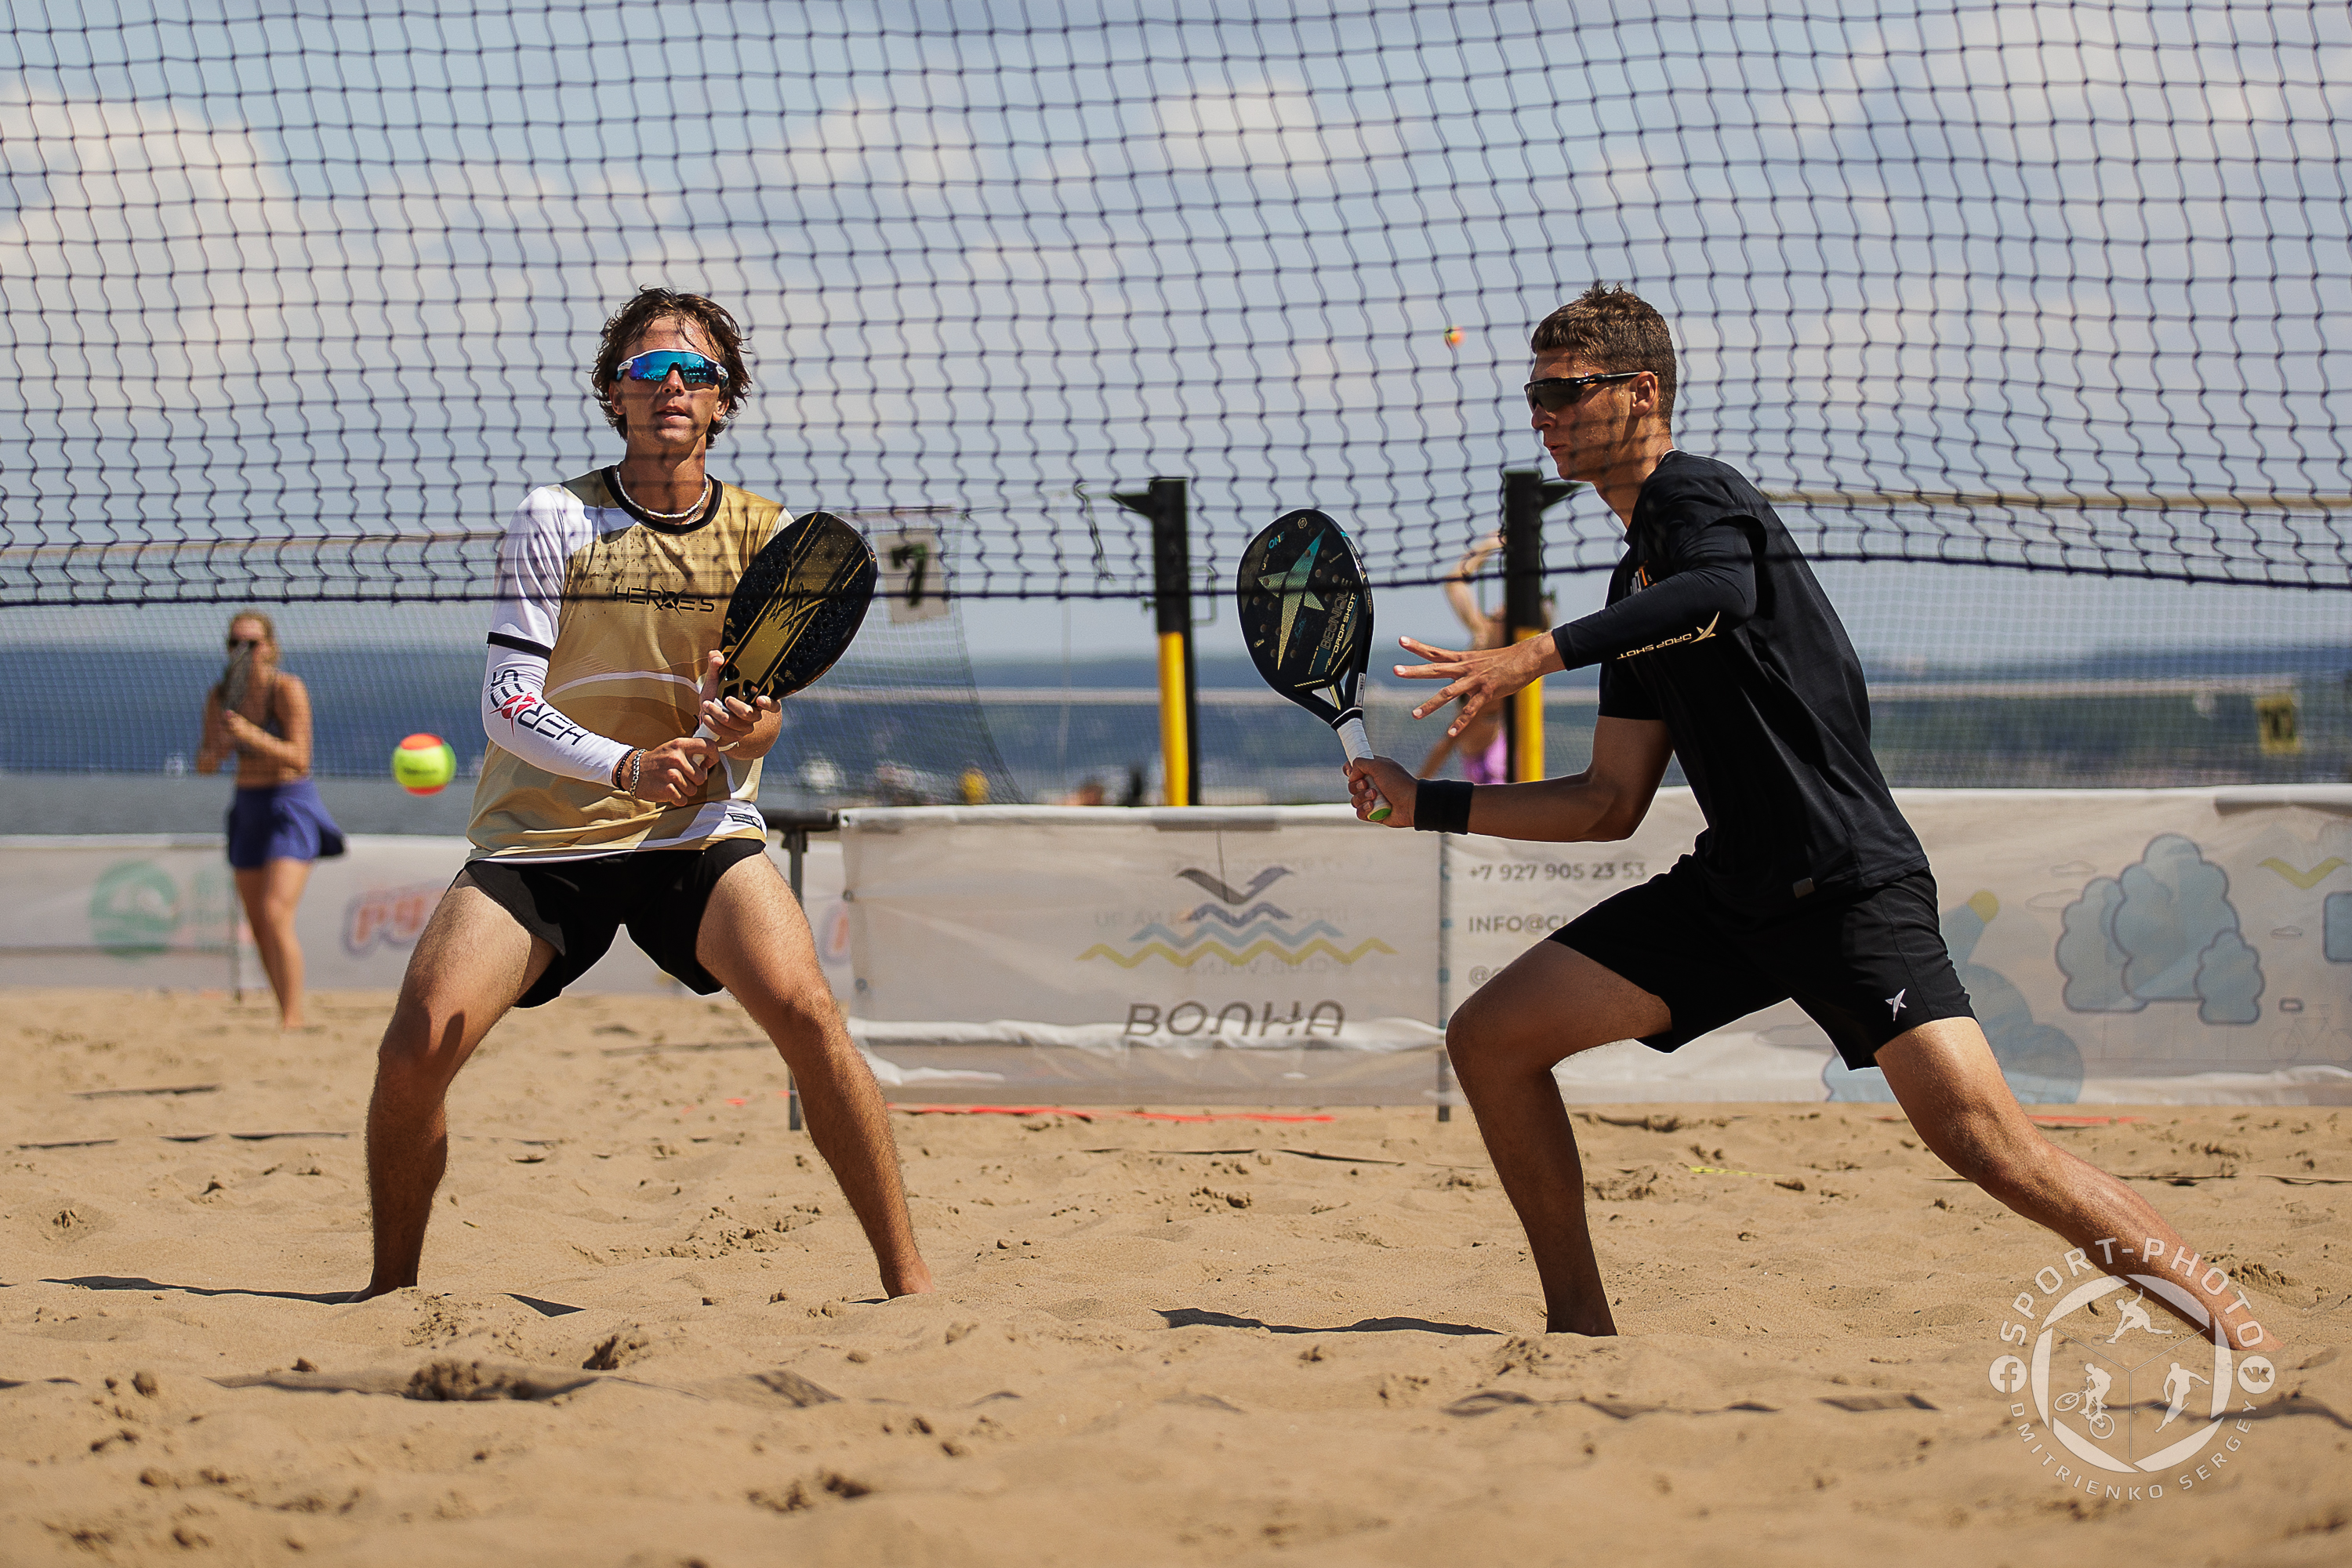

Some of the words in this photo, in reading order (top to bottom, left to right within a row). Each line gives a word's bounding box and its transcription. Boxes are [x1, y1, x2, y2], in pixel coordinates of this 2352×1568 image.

[1268, 531, 1286, 550] ONE
[1334, 623, 1345, 653] DROP
[1656, 633, 1692, 648] DROP
[1617, 644, 1654, 659] SHOT
[1470, 864, 1493, 881] +7
[1499, 864, 1537, 881] 927
[1544, 862, 1585, 880] 905
[1592, 862, 1617, 880] 23
[1622, 862, 1645, 879] 53
[1124, 1000, 1346, 1037] ВОЛНА
